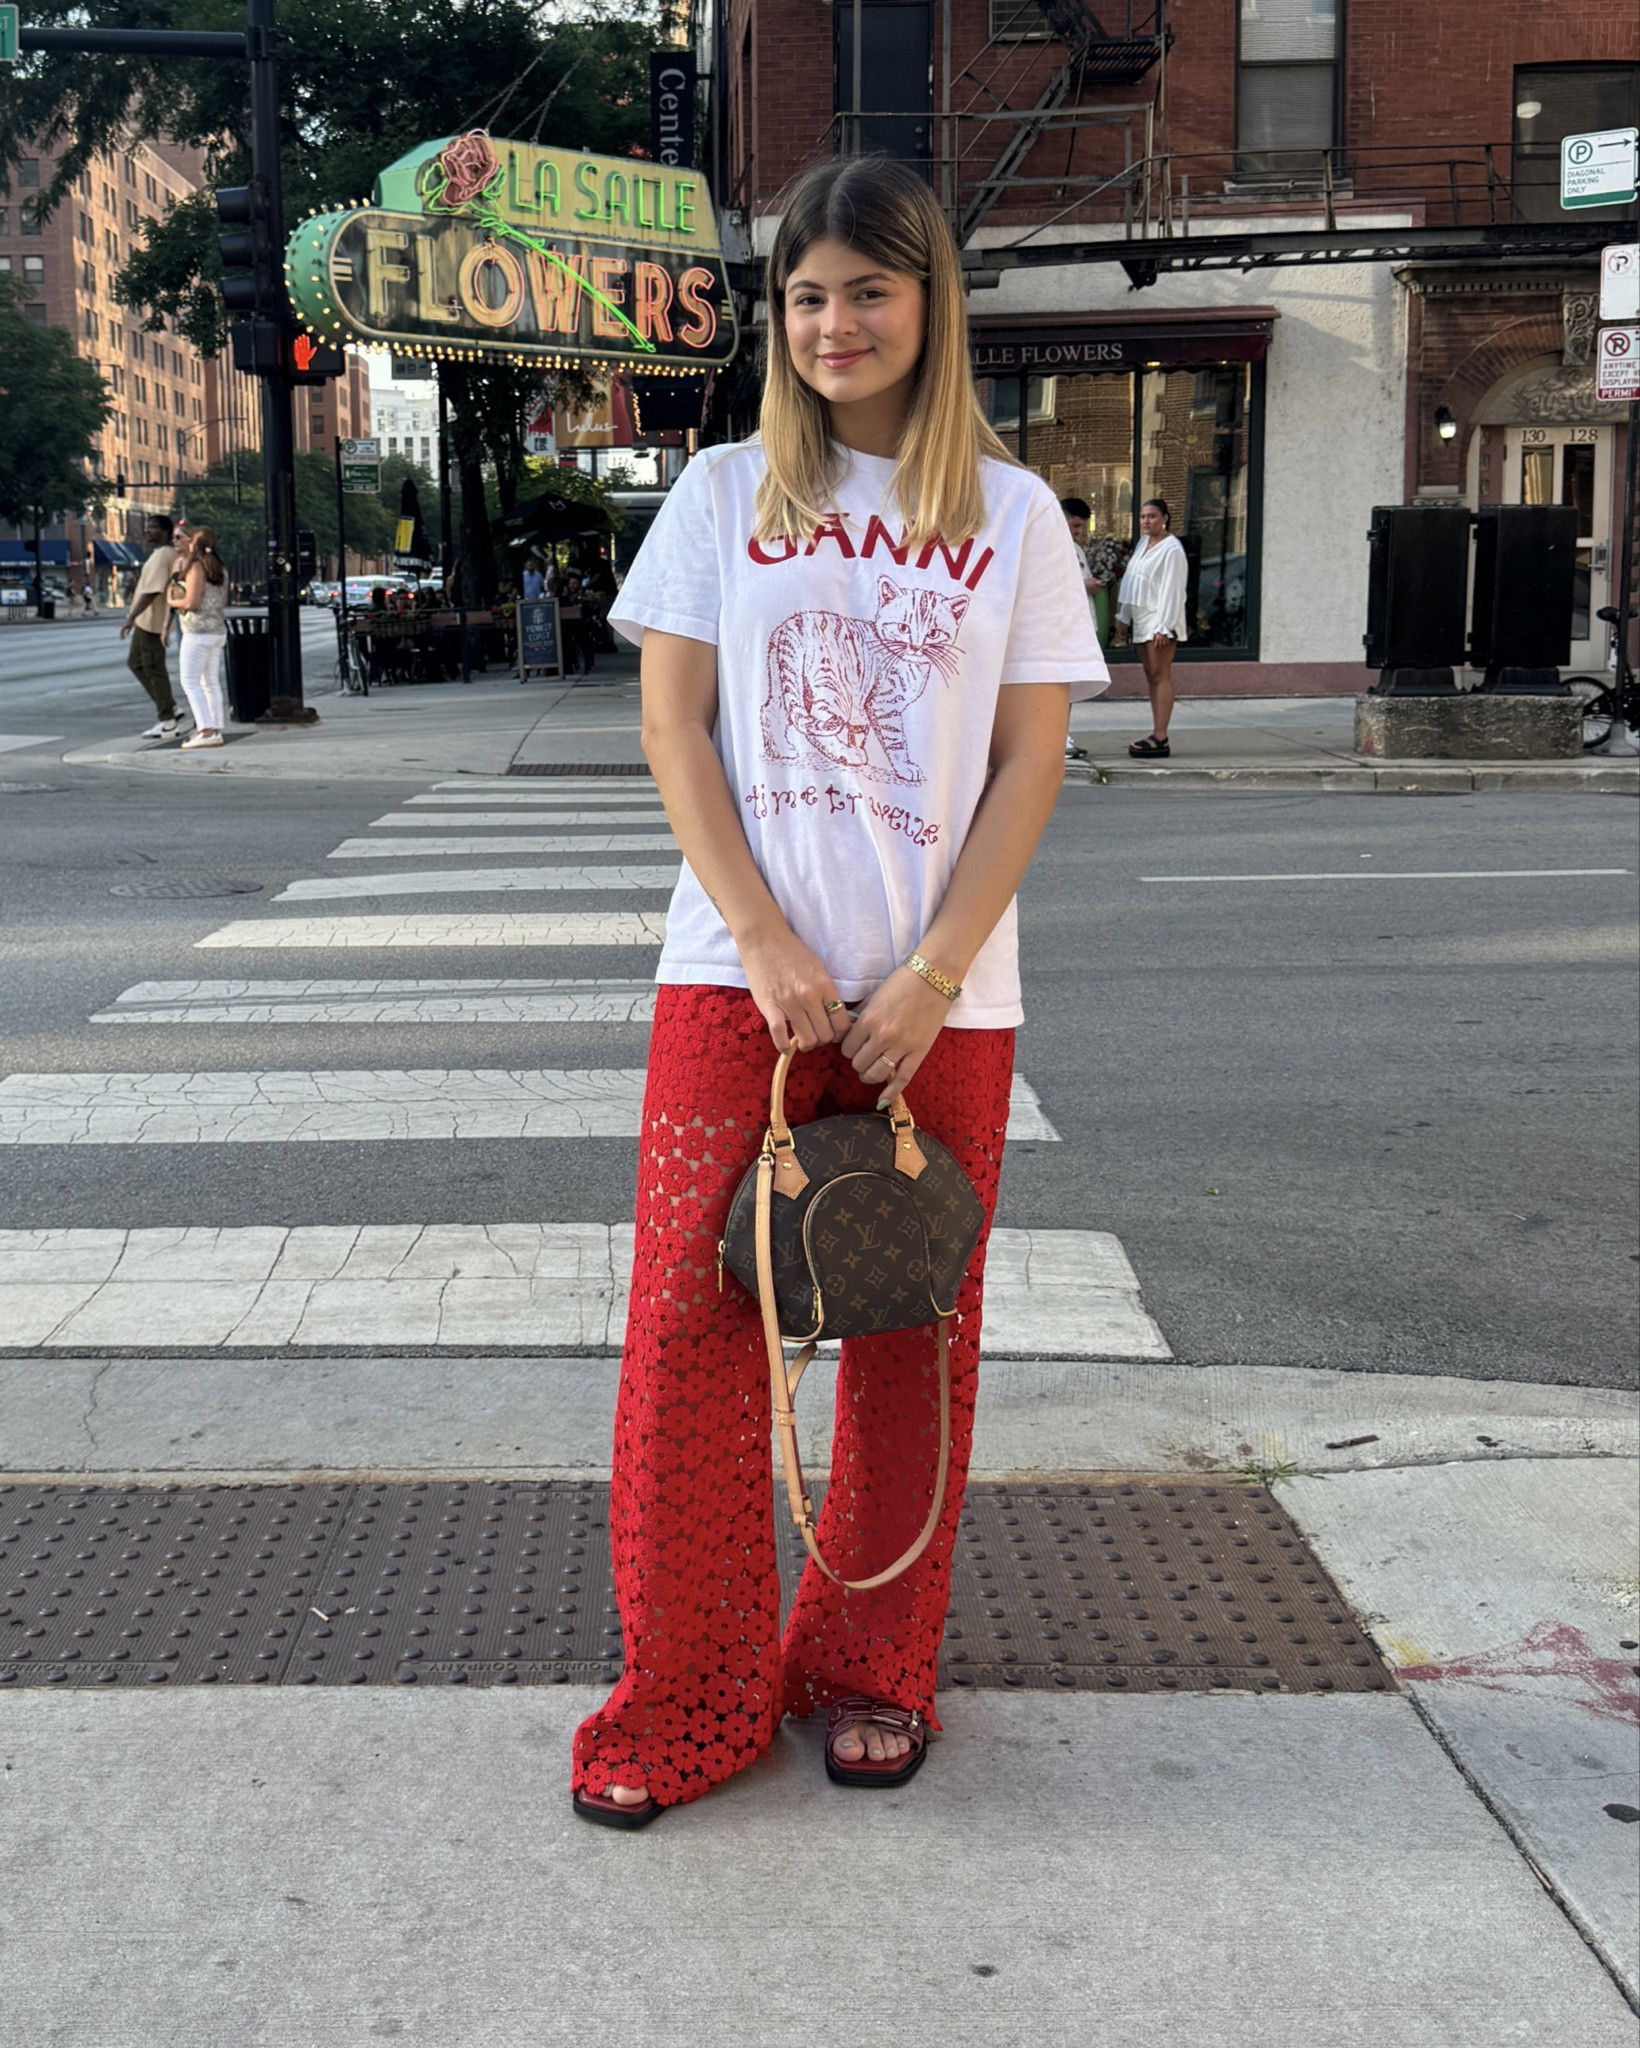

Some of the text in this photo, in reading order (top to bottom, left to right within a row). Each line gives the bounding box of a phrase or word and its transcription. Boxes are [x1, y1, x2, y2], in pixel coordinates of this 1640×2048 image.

[1567, 168, 1606, 178] DIAGONAL
[1567, 176, 1599, 186] PARKING
[509, 150, 698, 234] LA SALLE
[1567, 186, 1586, 194] ONLY
[365, 229, 717, 349] FLOWERS
[972, 342, 1123, 365] LLE FLOWERS
[1602, 370, 1629, 378] EXCEPT
[1602, 388, 1637, 398] PERMIT
[1522, 428, 1598, 443] 130 128
[747, 512, 995, 592] GANNI
[428, 1662, 613, 1672] FOUNDRY COMPANY
